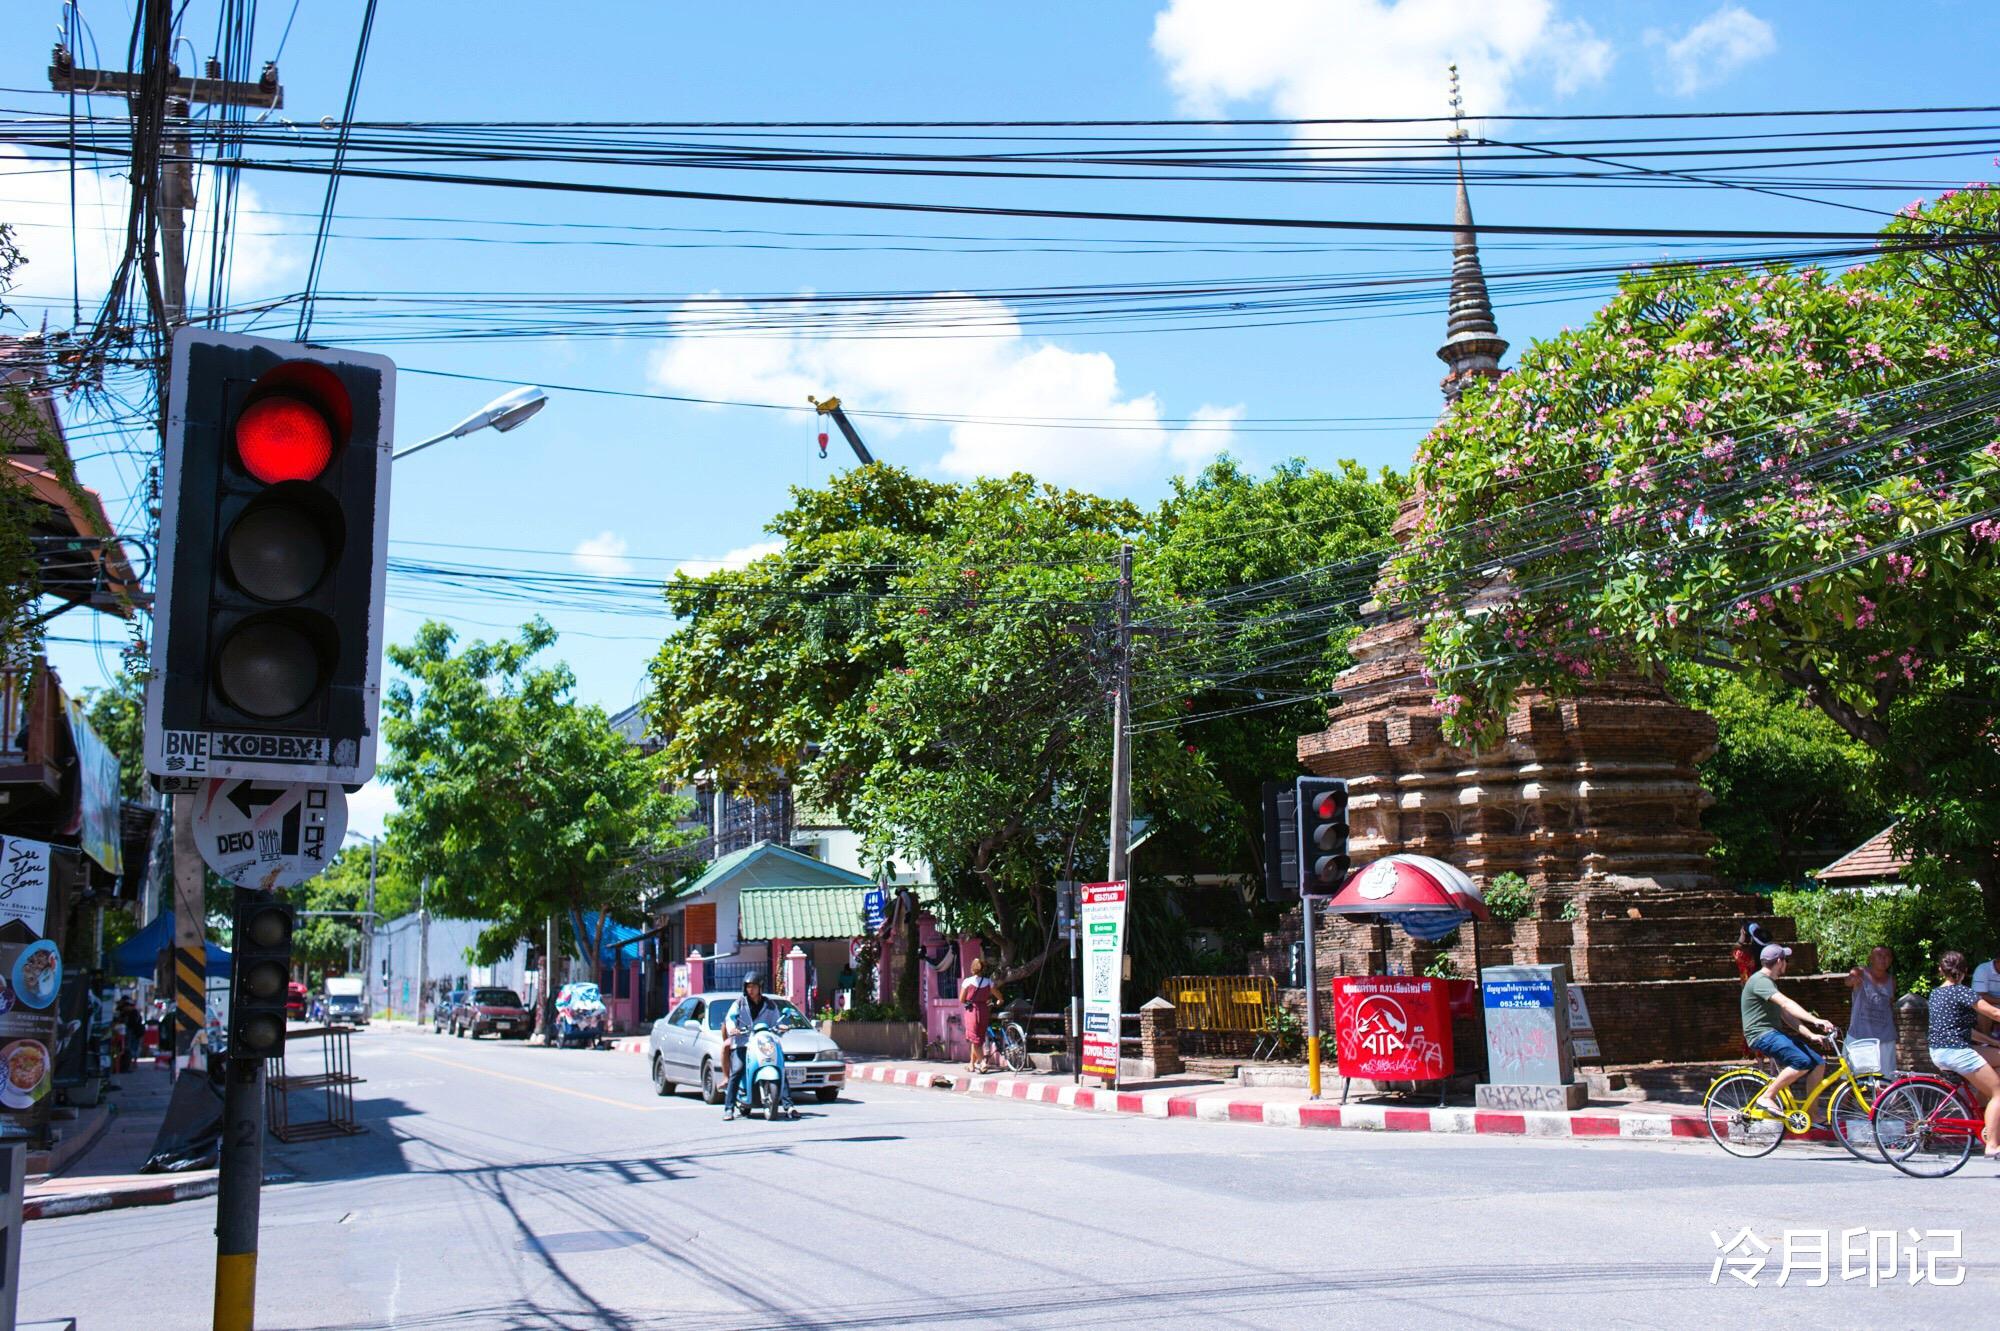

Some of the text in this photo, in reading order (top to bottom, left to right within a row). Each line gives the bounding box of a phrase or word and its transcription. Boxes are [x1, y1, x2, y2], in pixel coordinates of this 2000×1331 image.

[166, 732, 207, 756] BNE
[166, 756, 206, 772] 参上
[9, 840, 39, 862] See
[12, 861, 45, 884] You
[0, 873, 43, 899] Soon
[1362, 1034, 1405, 1055] AIA
